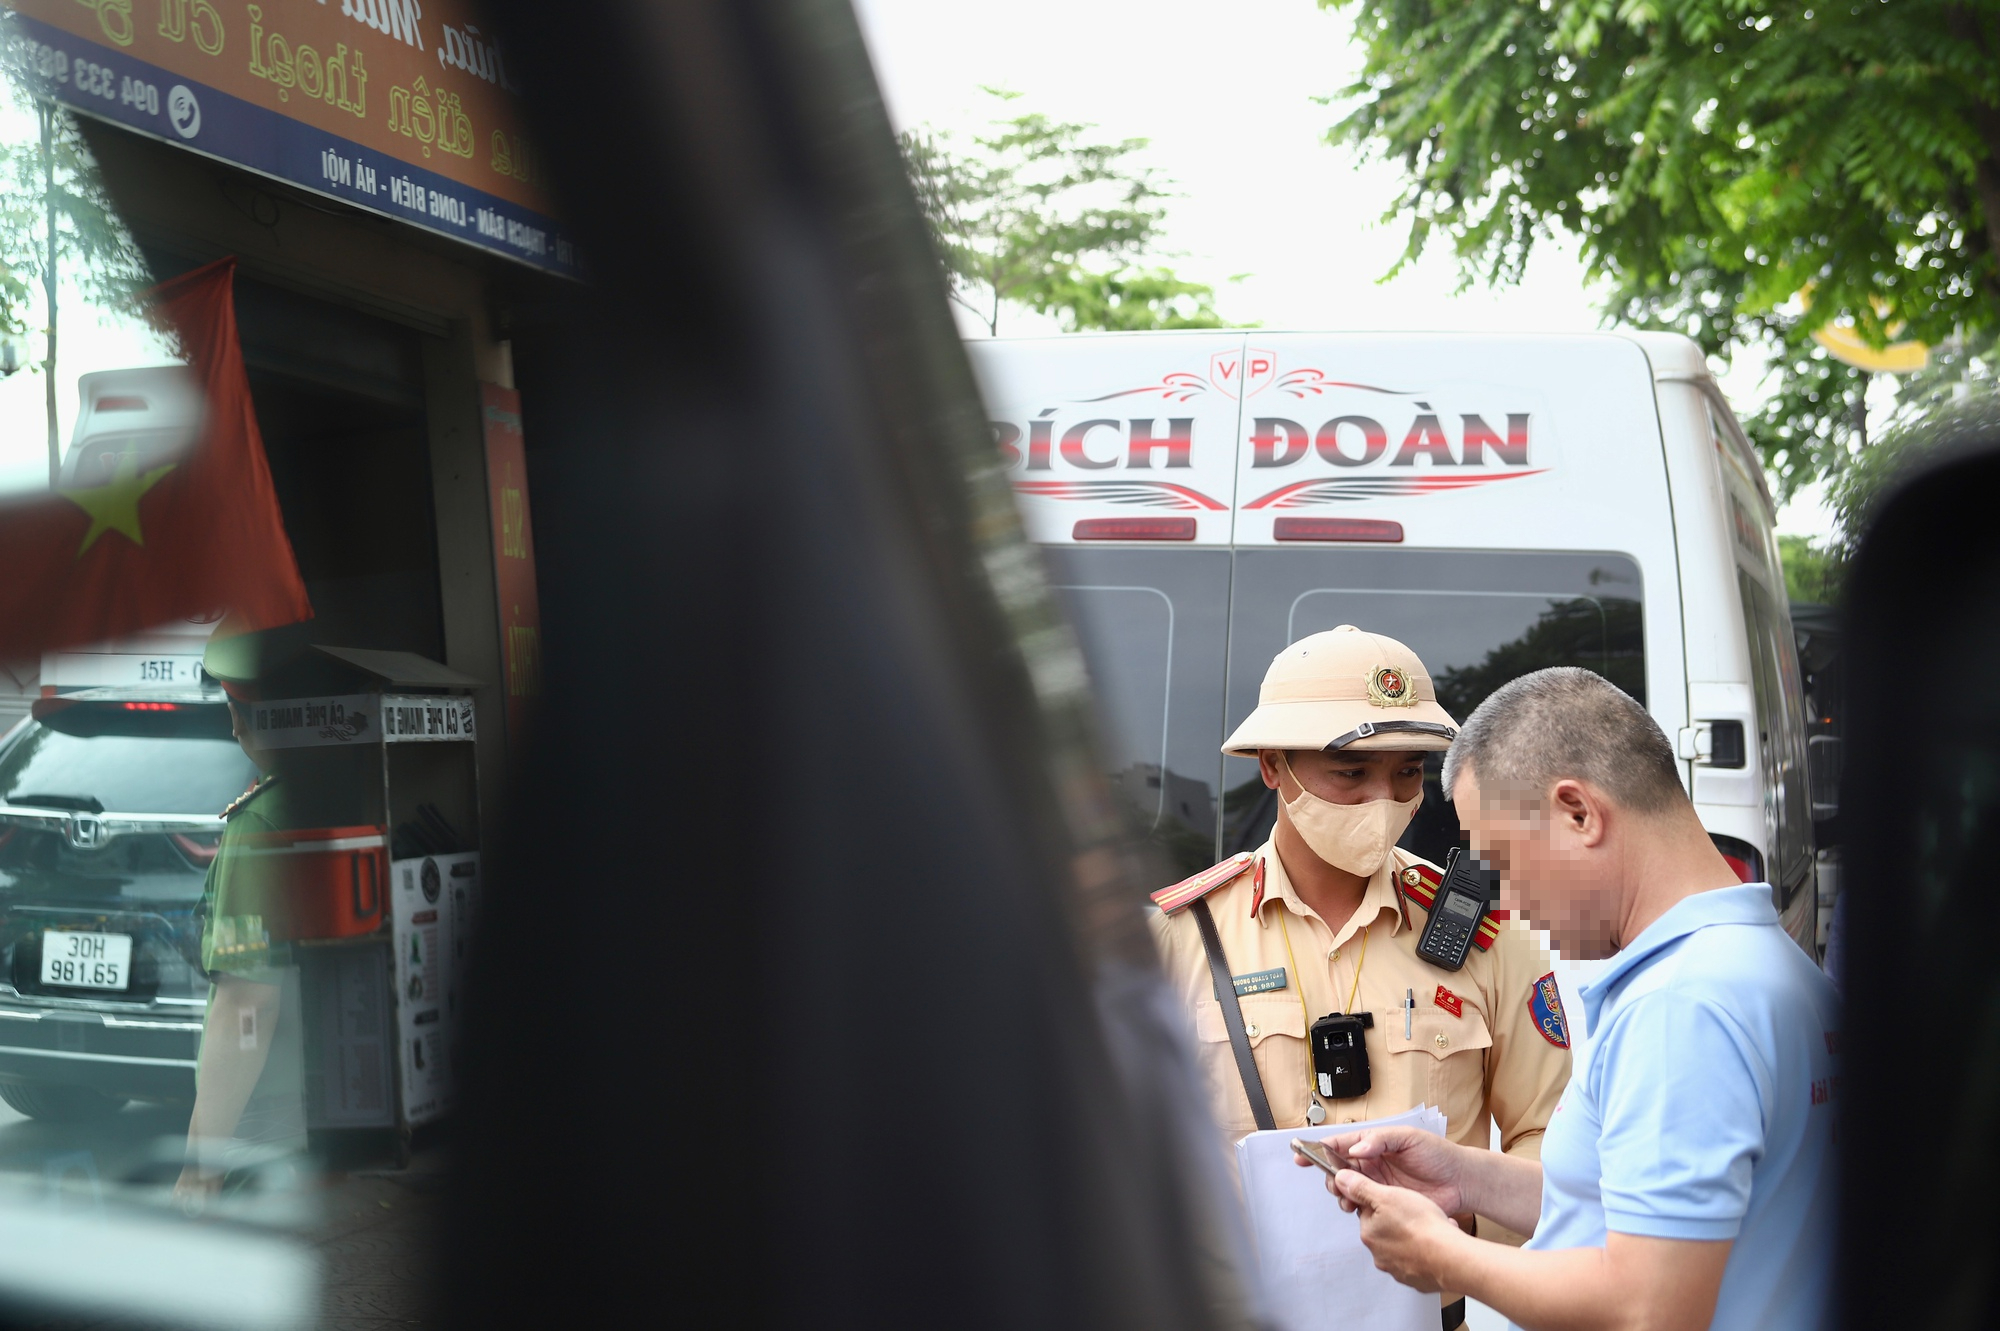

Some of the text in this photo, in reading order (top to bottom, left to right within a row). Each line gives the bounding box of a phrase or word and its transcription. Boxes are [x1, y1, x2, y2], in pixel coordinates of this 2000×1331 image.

[1218, 359, 1269, 380] VIP
[1249, 401, 1530, 468] ĐOÀN
[139, 660, 174, 681] 15H
[67, 936, 105, 960] 30H
[51, 960, 119, 985] 981.65
